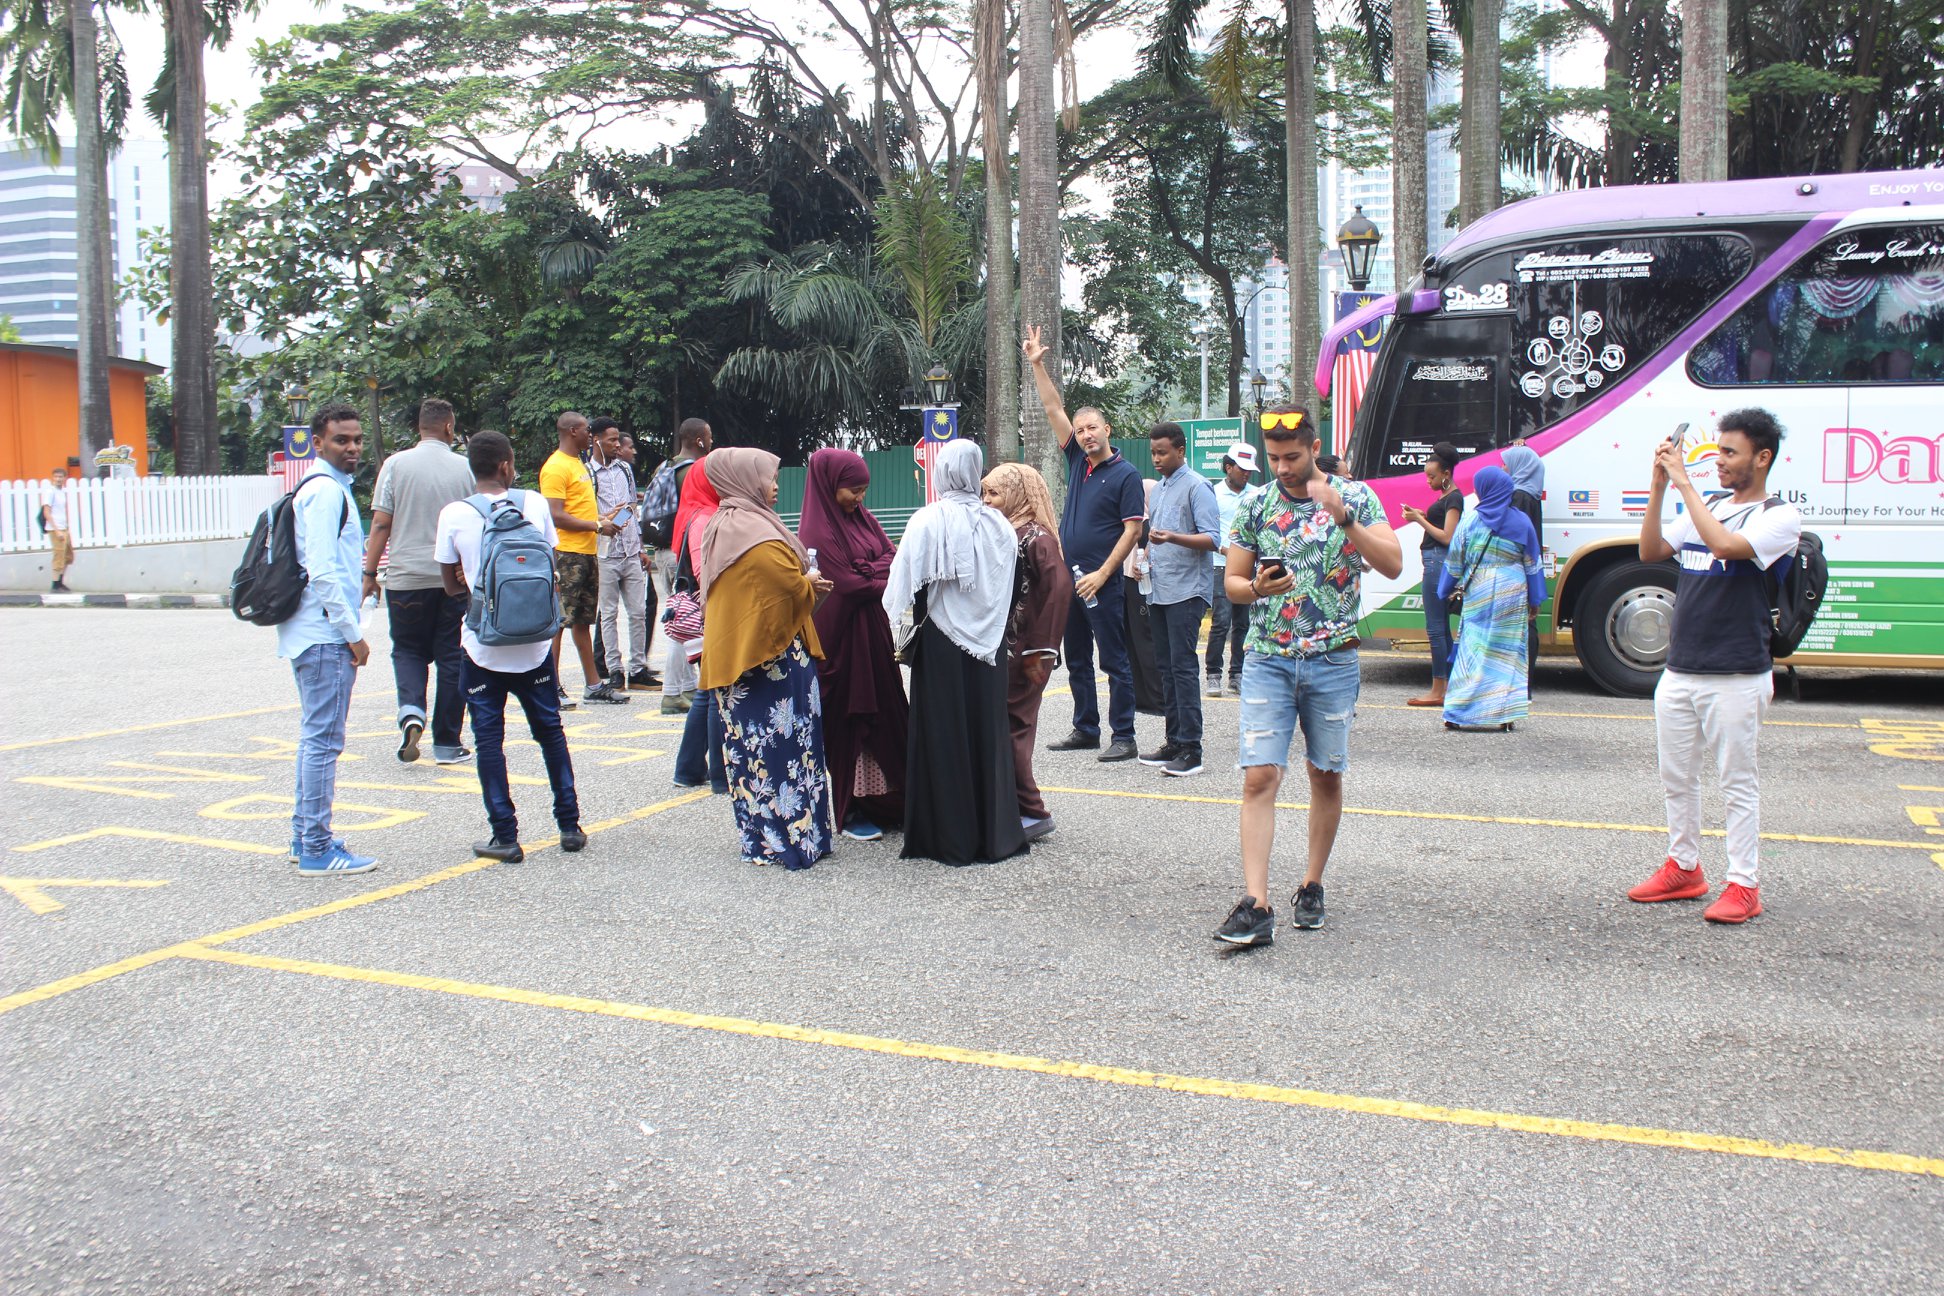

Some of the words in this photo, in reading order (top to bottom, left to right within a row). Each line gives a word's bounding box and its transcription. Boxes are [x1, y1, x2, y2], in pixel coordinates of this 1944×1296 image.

[1869, 184, 1919, 196] ENJOY
[1516, 251, 1592, 268] Dataran
[1592, 248, 1653, 263] Pintar
[1831, 243, 1885, 264] Luxury
[1886, 240, 1931, 258] Coach
[1195, 428, 1213, 440] Tempat
[1213, 427, 1240, 439] berkumpul
[1389, 454, 1416, 466] KCA
[1417, 454, 1431, 466] 2
[1788, 490, 1807, 503] Us
[1818, 505, 1869, 519] Journey
[1873, 505, 1892, 516] For
[1896, 505, 1926, 516] Your
[534, 675, 551, 685] AABE
